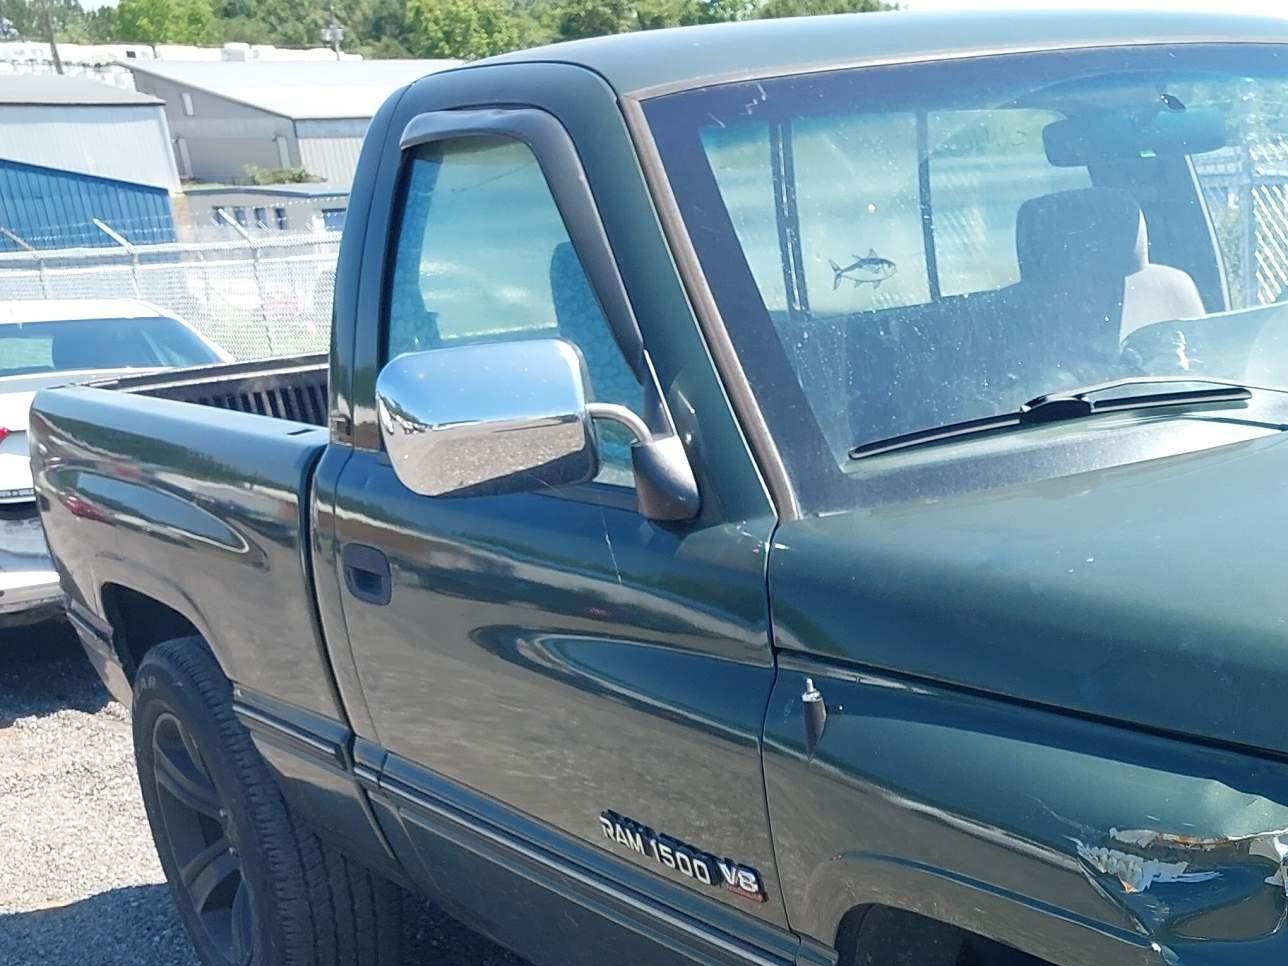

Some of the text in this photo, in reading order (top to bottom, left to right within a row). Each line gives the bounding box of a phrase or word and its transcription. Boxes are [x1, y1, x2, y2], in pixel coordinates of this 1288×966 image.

[600, 812, 761, 894] RAM 1500 V8
